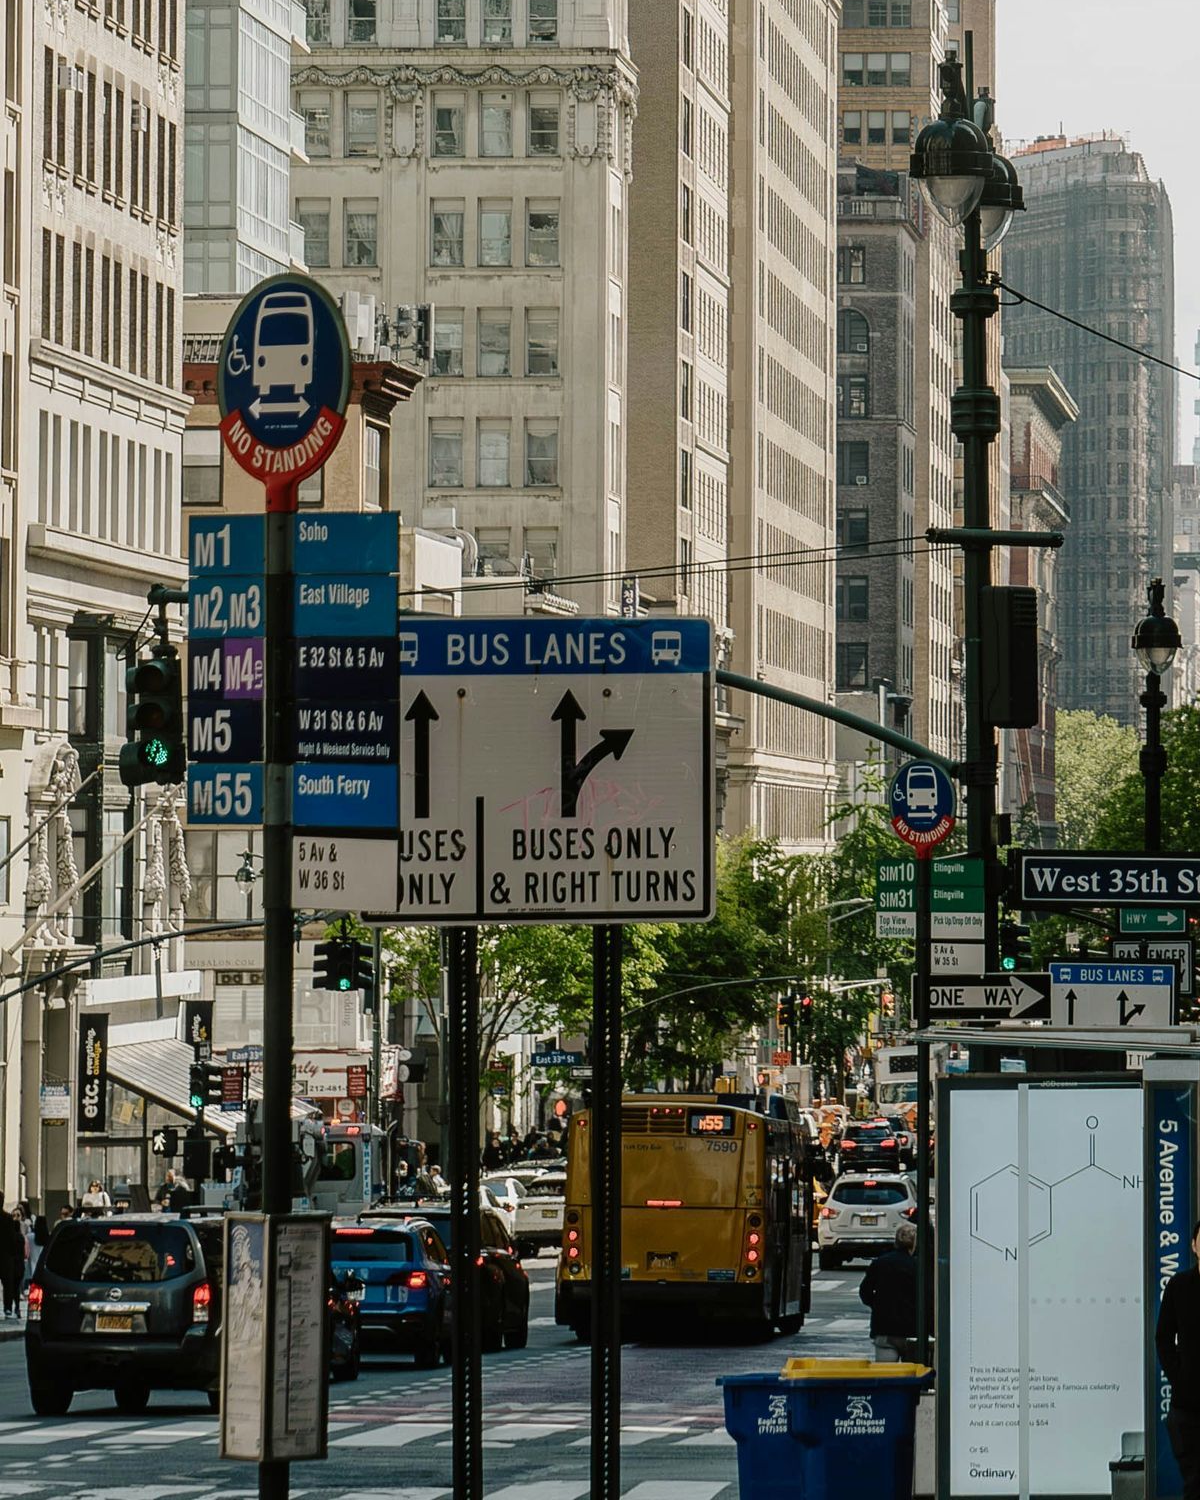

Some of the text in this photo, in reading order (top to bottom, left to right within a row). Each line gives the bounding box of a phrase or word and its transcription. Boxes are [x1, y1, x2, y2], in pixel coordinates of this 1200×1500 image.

[228, 416, 333, 473] NO STANDING
[299, 521, 328, 542] Soho
[194, 523, 231, 568] M1
[299, 583, 370, 609] East Village
[194, 585, 261, 635] M2,M3
[300, 647, 384, 668] E 32 St & 5 Av
[447, 632, 627, 666] BUS LANES
[193, 648, 263, 691] M4 M4 LTD
[300, 710, 384, 732] W 31 St & 6 Av
[193, 709, 232, 754] M5
[298, 742, 390, 759] Night & Weekend Service Only
[193, 772, 252, 817] M55
[298, 774, 370, 800] South Ferry
[896, 818, 950, 843] NO STANDING
[299, 842, 337, 862] 5 Av &
[512, 828, 594, 861] BUSES
[605, 827, 675, 859] ONLY
[299, 869, 345, 890] W 36 St
[879, 862, 964, 882] SIM10 Eltingville
[1030, 867, 1101, 892] West
[1108, 868, 1168, 894] 35th
[490, 872, 511, 905] &
[524, 871, 600, 904] RIGHT
[610, 870, 696, 902] TURNS
[879, 889, 964, 908] SIM31 Eltingville
[879, 915, 907, 926] Top View
[934, 916, 944, 924] Pick
[972, 916, 982, 927] Only
[1126, 914, 1147, 924] HWY
[880, 926, 914, 936] Sightseeing
[934, 946, 954, 954] 5 Av &
[1118, 949, 1186, 963] PASENGER
[934, 957, 958, 966] W 35 St
[1080, 969, 1144, 982] BUS LANES
[930, 988, 1024, 1006] ONE WAY
[232, 1051, 249, 1060] East
[535, 1055, 574, 1064] East 33rd St
[82, 1079, 99, 1118] etc.
[698, 1115, 724, 1130] M55
[1159, 1119, 1178, 1133] 5
[706, 1140, 738, 1153] 7590
[1158, 1139, 1179, 1225] Avenue
[1158, 1230, 1180, 1248] &
[835, 1418, 886, 1427] Eagle Disposal
